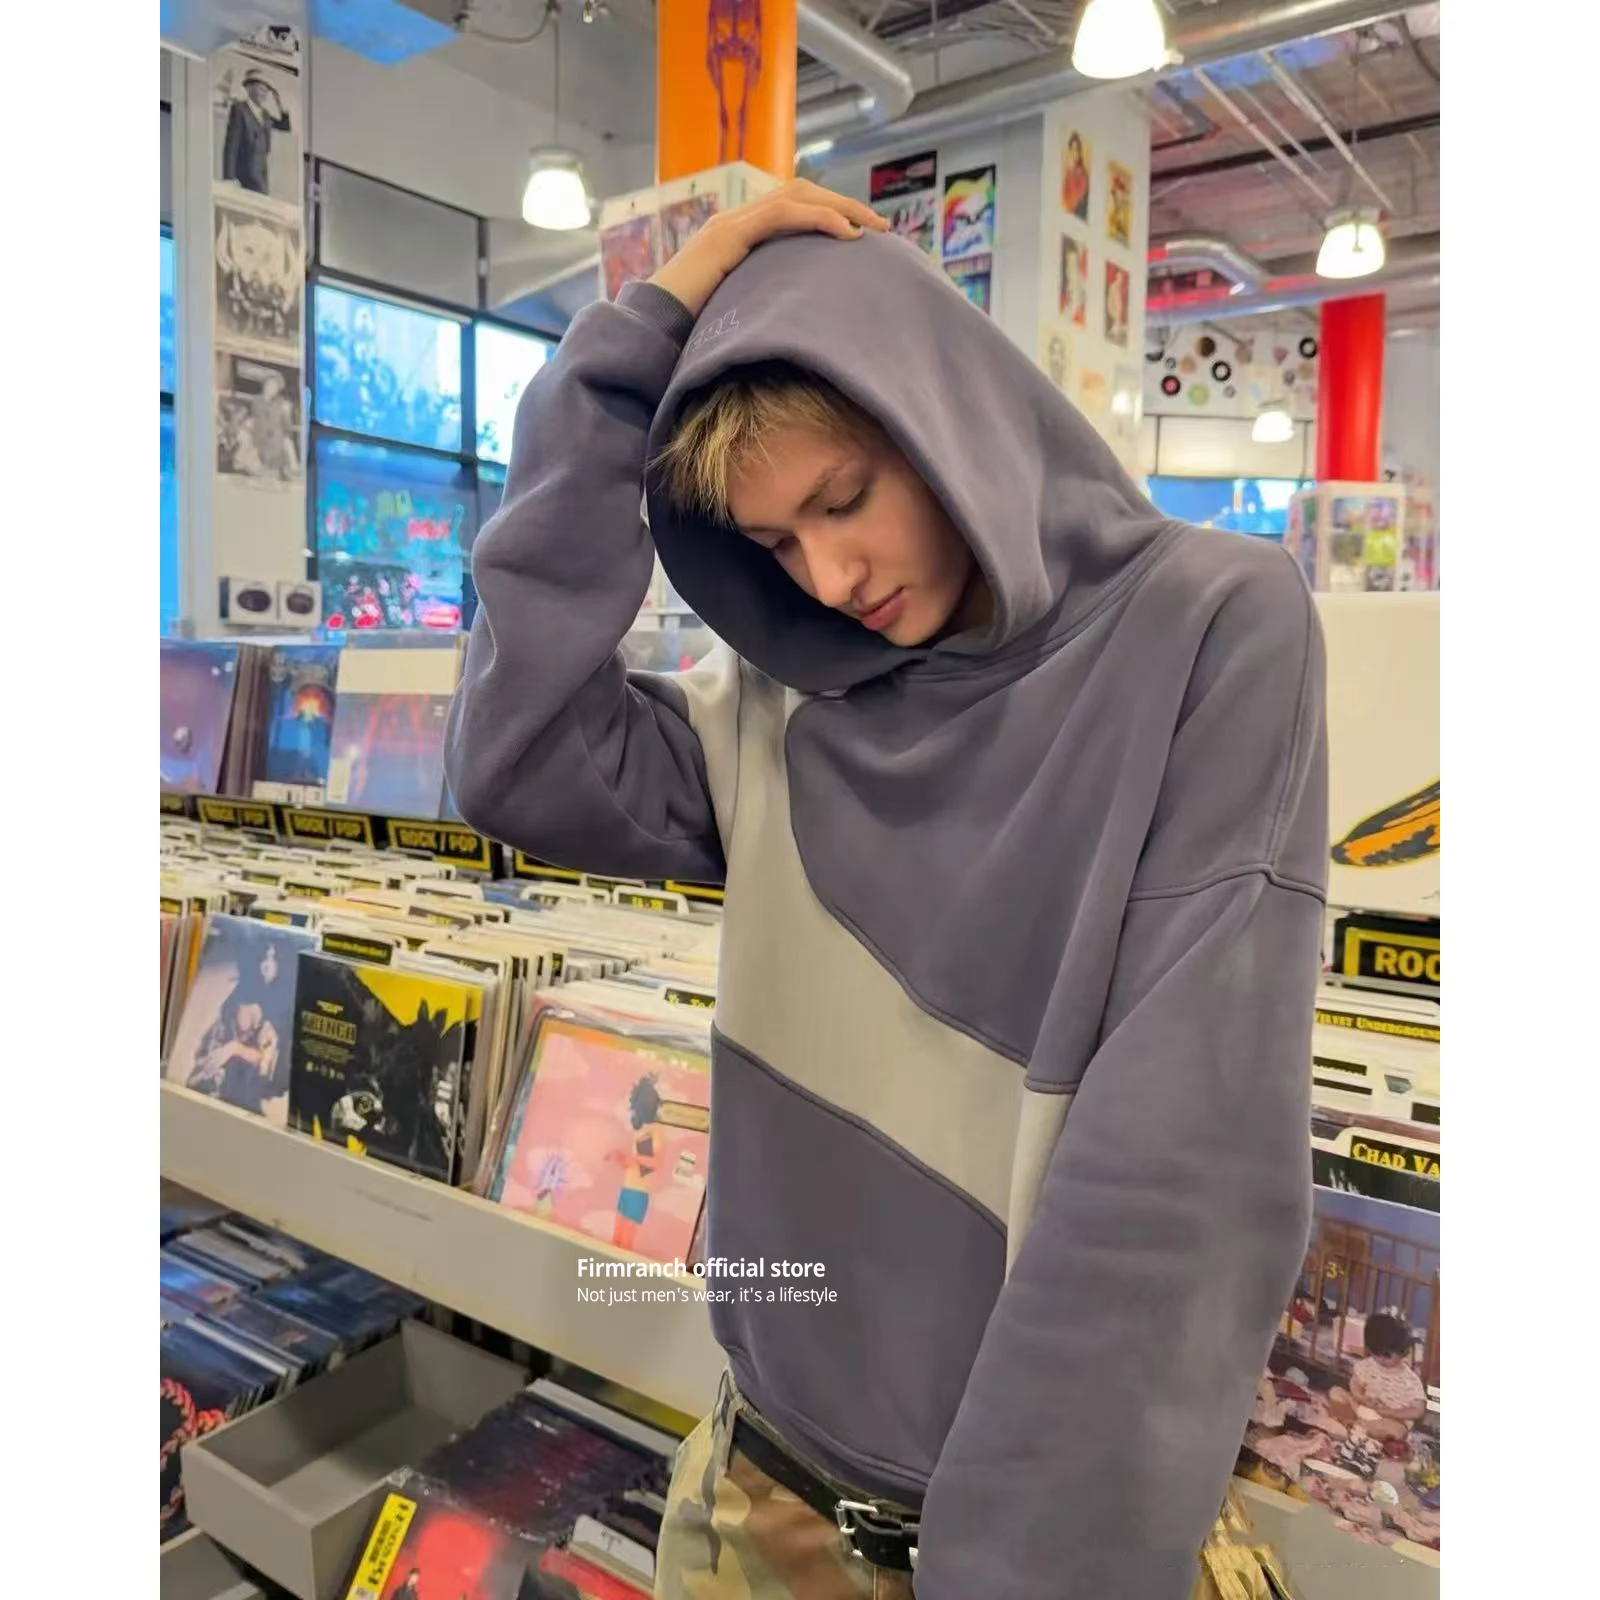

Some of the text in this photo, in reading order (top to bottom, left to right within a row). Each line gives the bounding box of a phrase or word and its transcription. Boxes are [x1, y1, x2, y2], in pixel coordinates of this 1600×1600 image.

[335, 820, 361, 838] POP
[399, 828, 437, 849] ROCK
[447, 832, 477, 853] POP
[1352, 1143, 1406, 1170] CHAD
